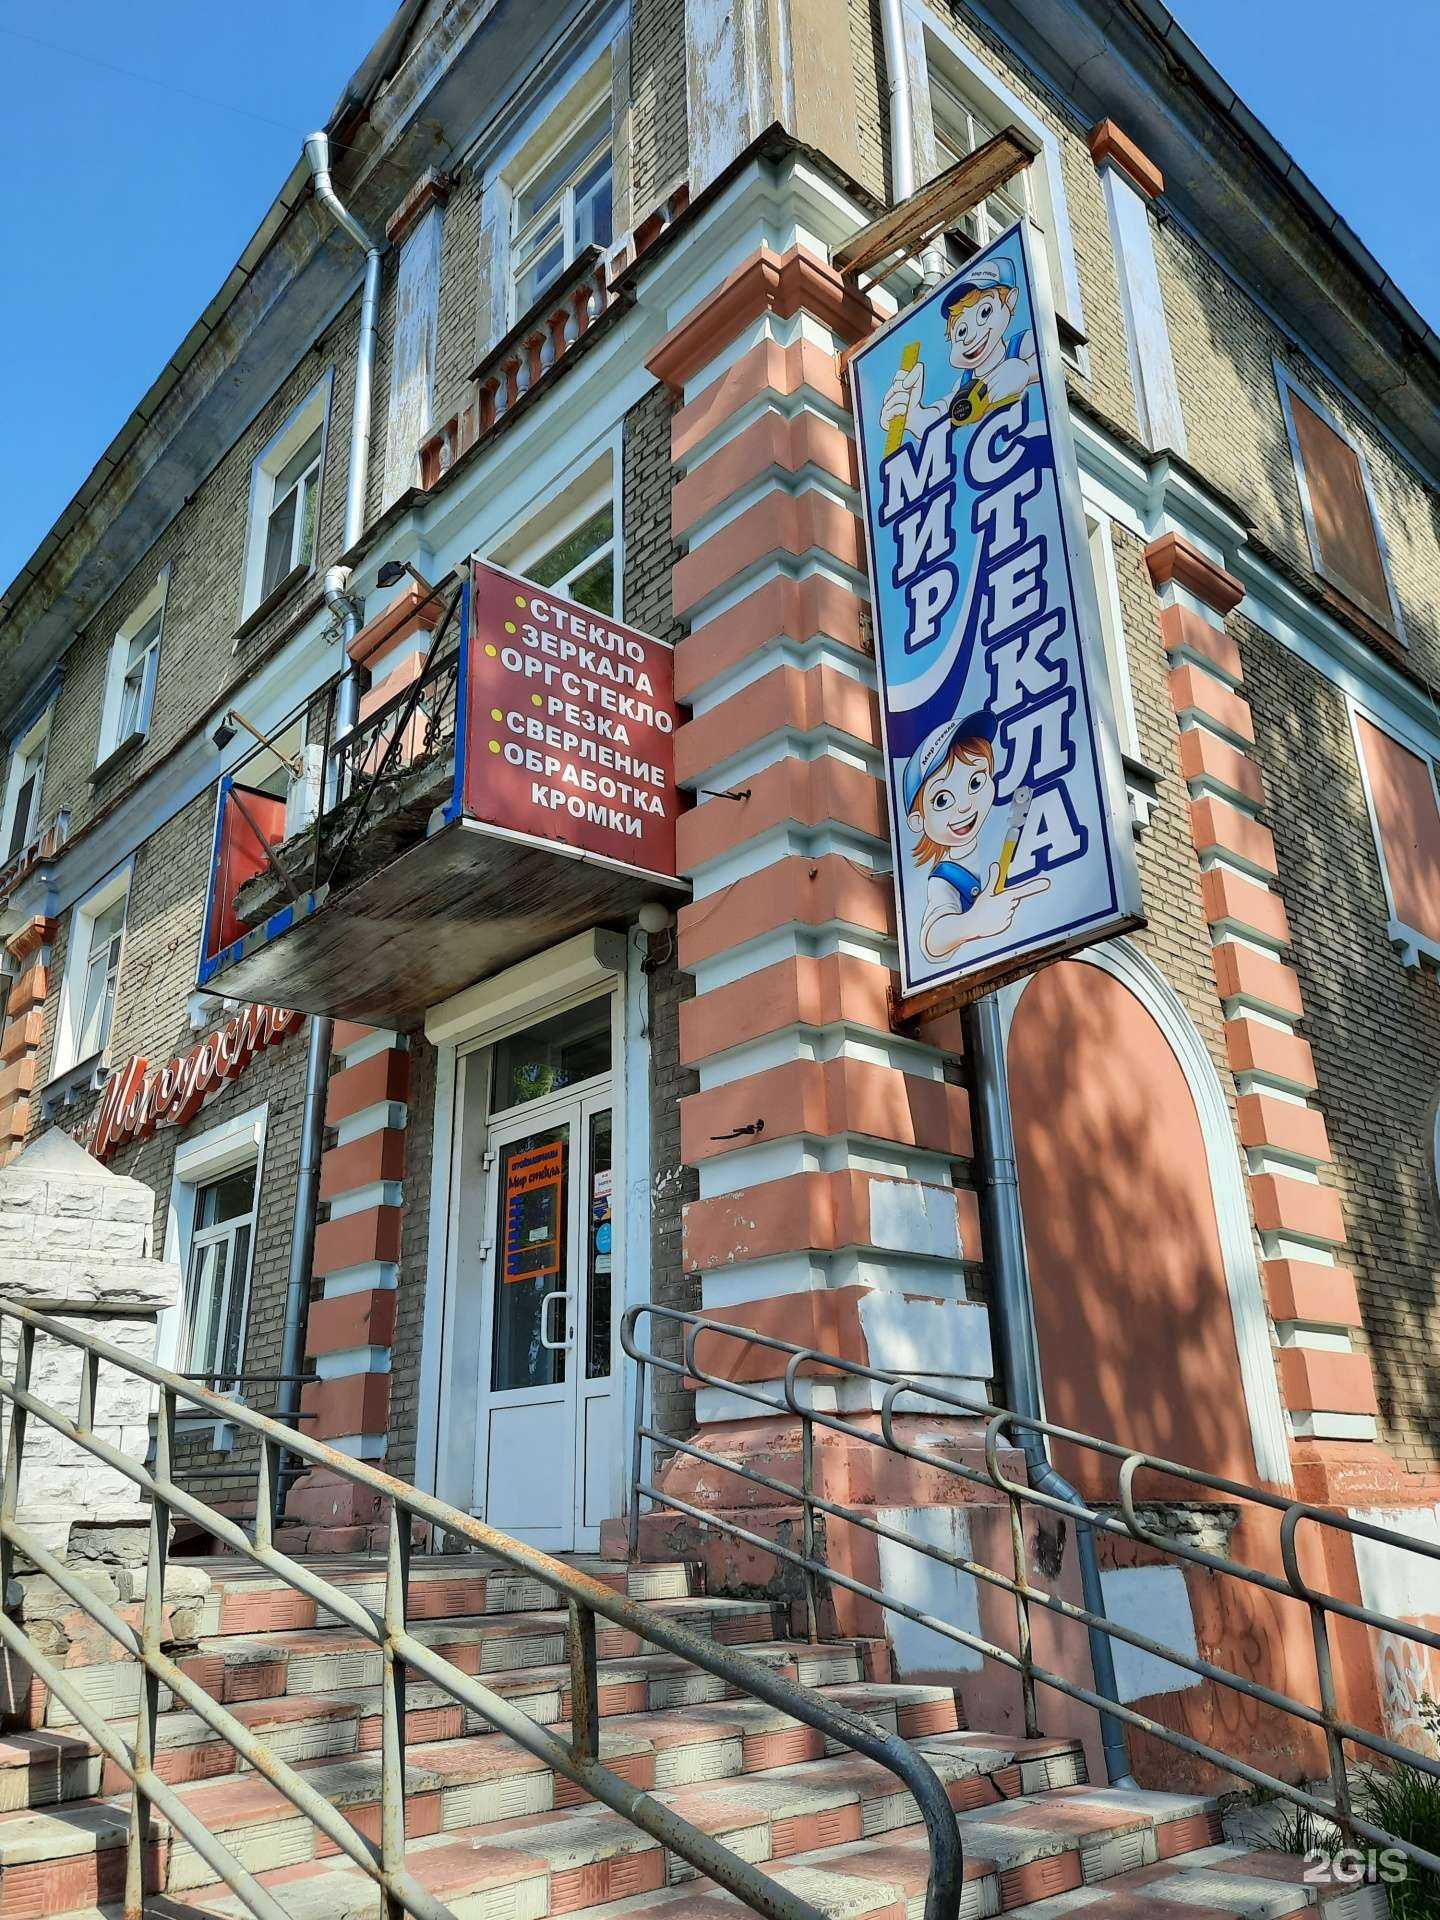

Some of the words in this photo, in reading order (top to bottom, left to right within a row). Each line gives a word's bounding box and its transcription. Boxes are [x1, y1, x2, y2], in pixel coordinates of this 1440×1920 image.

[881, 416, 957, 650] МИР
[521, 623, 654, 696] ЗЕРКАЛА
[530, 598, 645, 663] СТЕКЛО
[966, 398, 1085, 880] СТЕКЛА
[500, 647, 673, 733] ОРГСТЕКЛО
[547, 695, 631, 747] РЕЗКА
[504, 742, 666, 818] ОБРАБОТКА
[506, 711, 665, 789] СВЕРЛЕНИЕ
[532, 782, 643, 839] КРОМКИ
